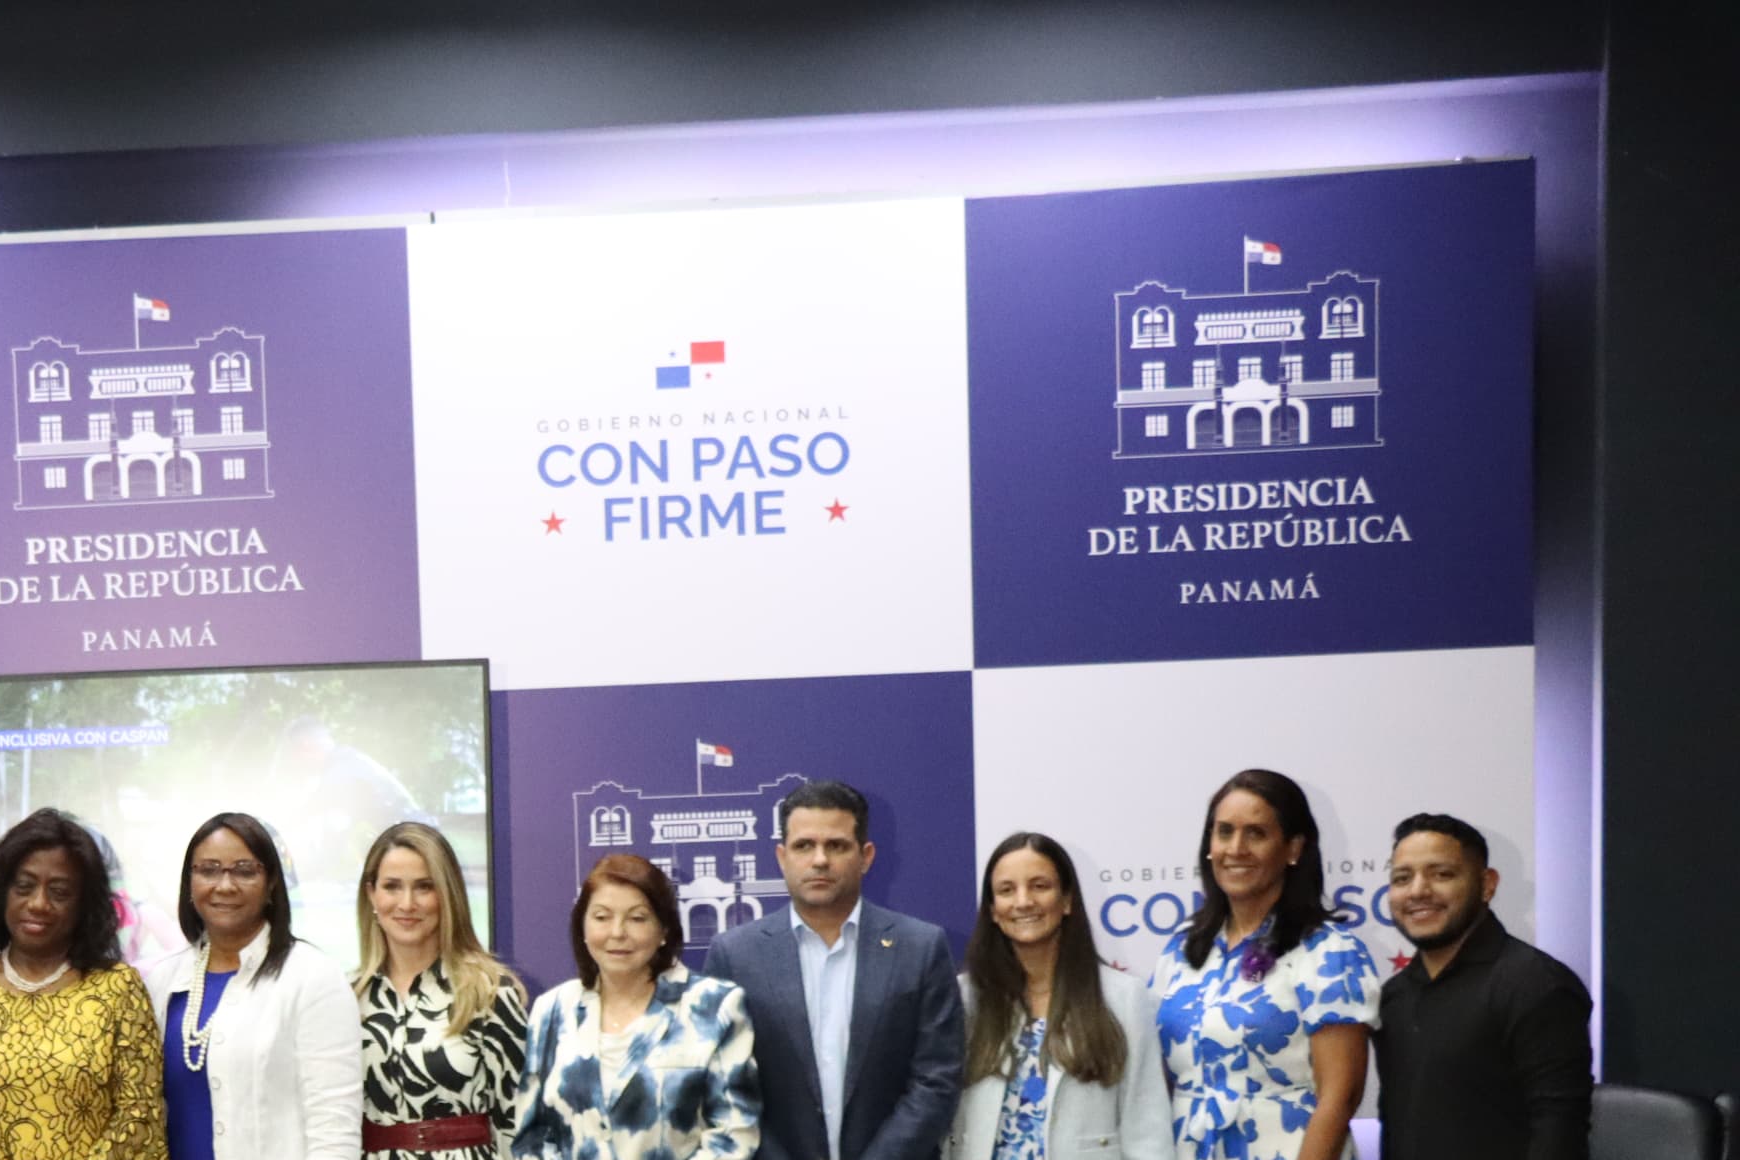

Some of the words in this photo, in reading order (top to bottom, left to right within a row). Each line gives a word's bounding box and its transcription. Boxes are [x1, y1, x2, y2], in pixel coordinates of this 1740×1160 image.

[536, 413, 683, 433] GOBIERNO
[702, 405, 849, 425] NACIONAL
[537, 439, 669, 488] CON
[692, 431, 850, 482] PASO
[1122, 477, 1375, 515] PRESIDENCIA
[603, 490, 787, 542] FIRME
[1087, 526, 1139, 556] DE
[1147, 524, 1196, 553] LA
[1203, 512, 1412, 551] REPÚBLICA
[25, 527, 268, 566] PRESIDENCIA
[50, 574, 95, 603] LA
[103, 562, 305, 600] REPÚBLICA
[1179, 572, 1321, 604] PANAMÁ
[82, 620, 217, 652] PANAMÁ
[74, 730, 106, 745] CON
[1099, 866, 1202, 883] GOBIER
